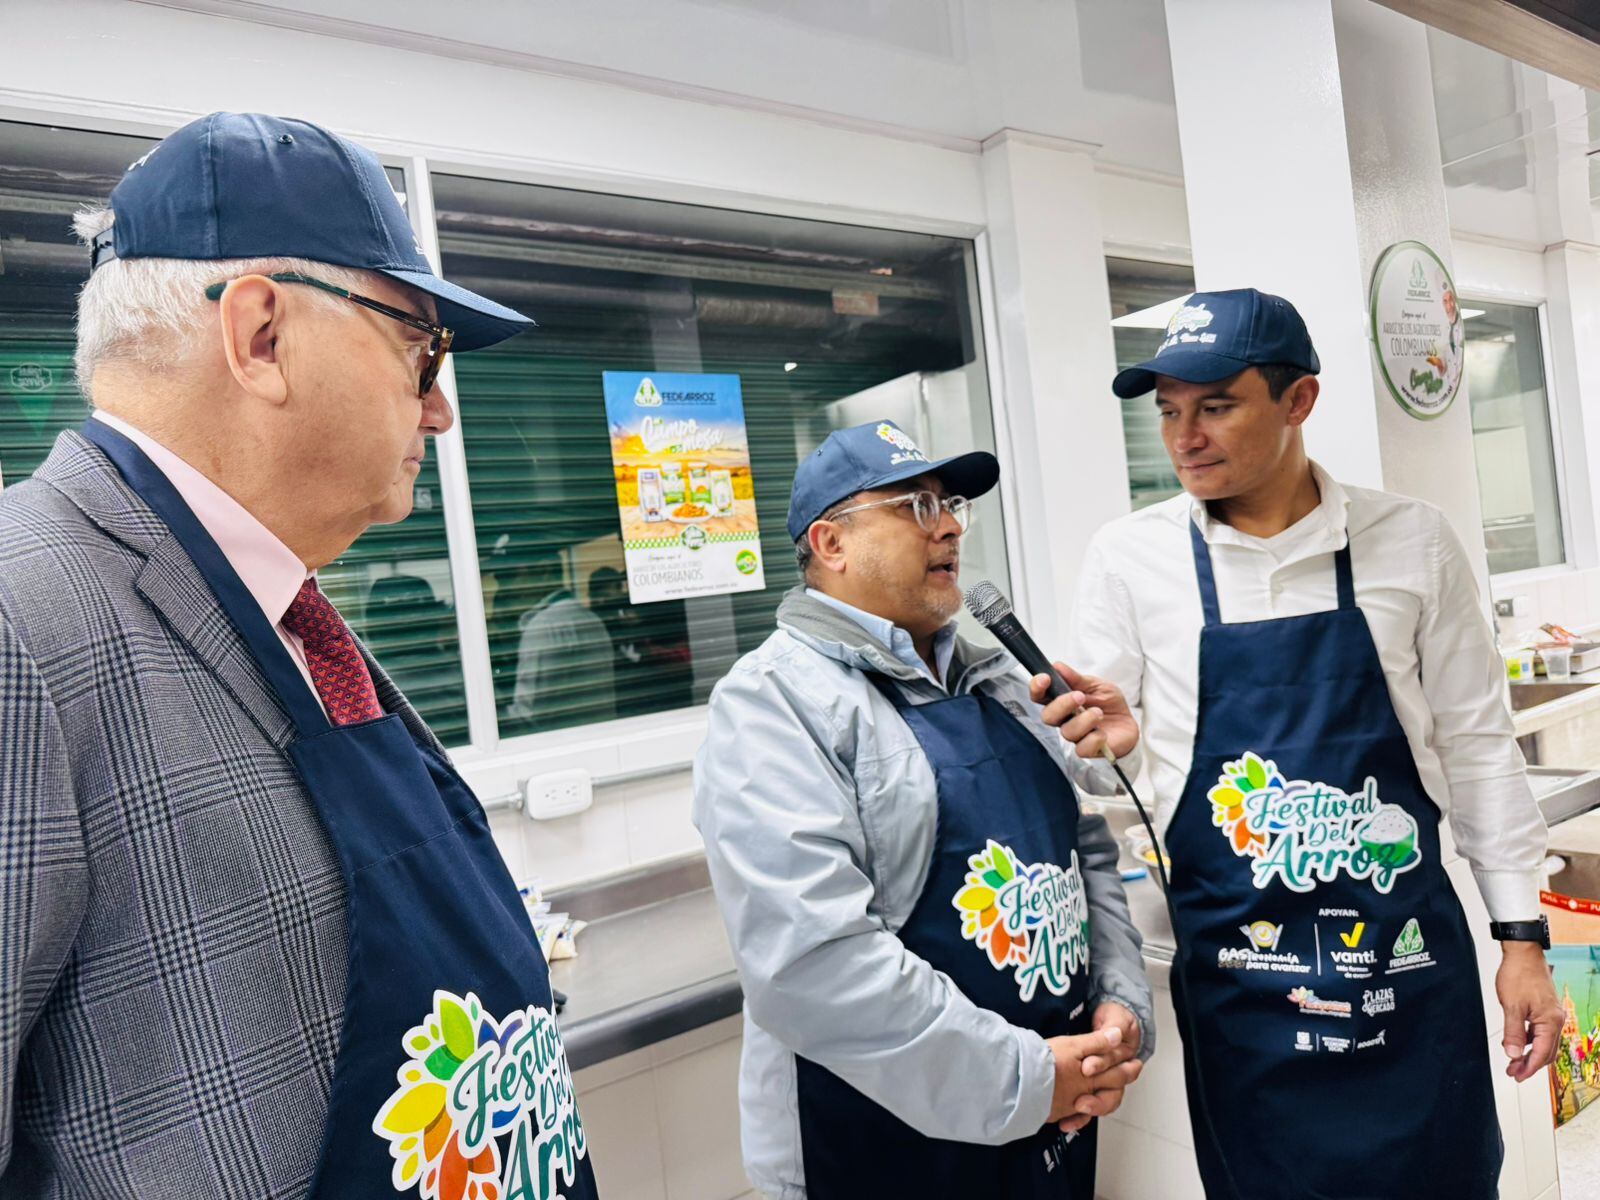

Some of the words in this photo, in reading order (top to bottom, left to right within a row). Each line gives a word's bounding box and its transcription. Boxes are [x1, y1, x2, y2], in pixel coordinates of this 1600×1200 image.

[1390, 337, 1437, 357] COLOMBIANOS
[633, 568, 704, 587] COLOMBIANOS
[1246, 781, 1377, 830] Festival
[1308, 819, 1349, 847] Del
[1258, 832, 1398, 888] Arroz
[999, 855, 1081, 931] Festival
[1020, 925, 1086, 995] Arro
[1245, 961, 1270, 971] para
[1270, 962, 1312, 973] avanzar
